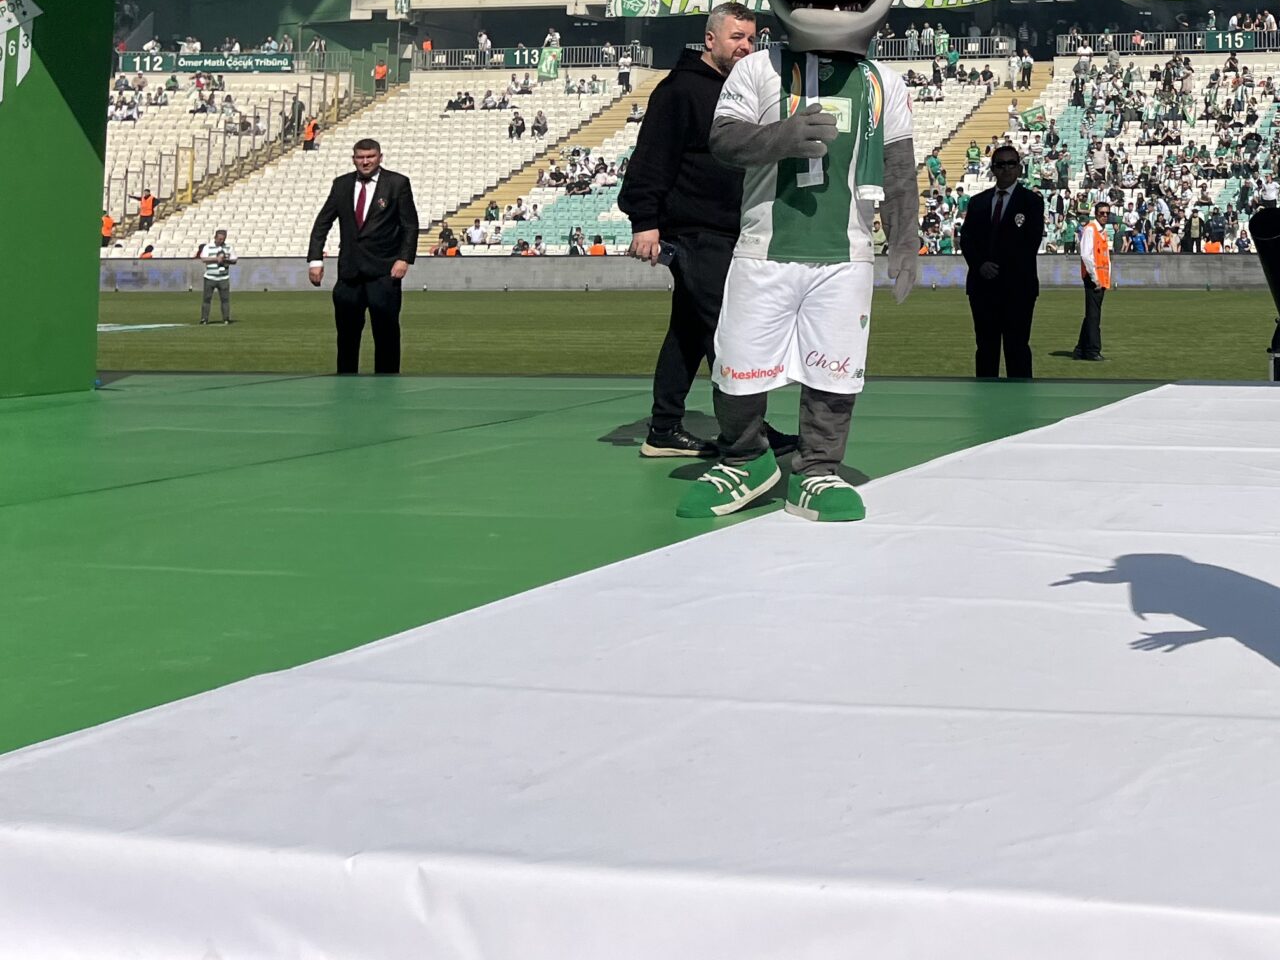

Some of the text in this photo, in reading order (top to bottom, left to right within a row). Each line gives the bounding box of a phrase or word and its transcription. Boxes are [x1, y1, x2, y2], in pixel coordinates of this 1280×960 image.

[1215, 31, 1244, 50] 115
[132, 55, 163, 72] 112
[178, 57, 202, 67] Ömer
[254, 57, 289, 67] Tribünü
[513, 49, 539, 65] 113
